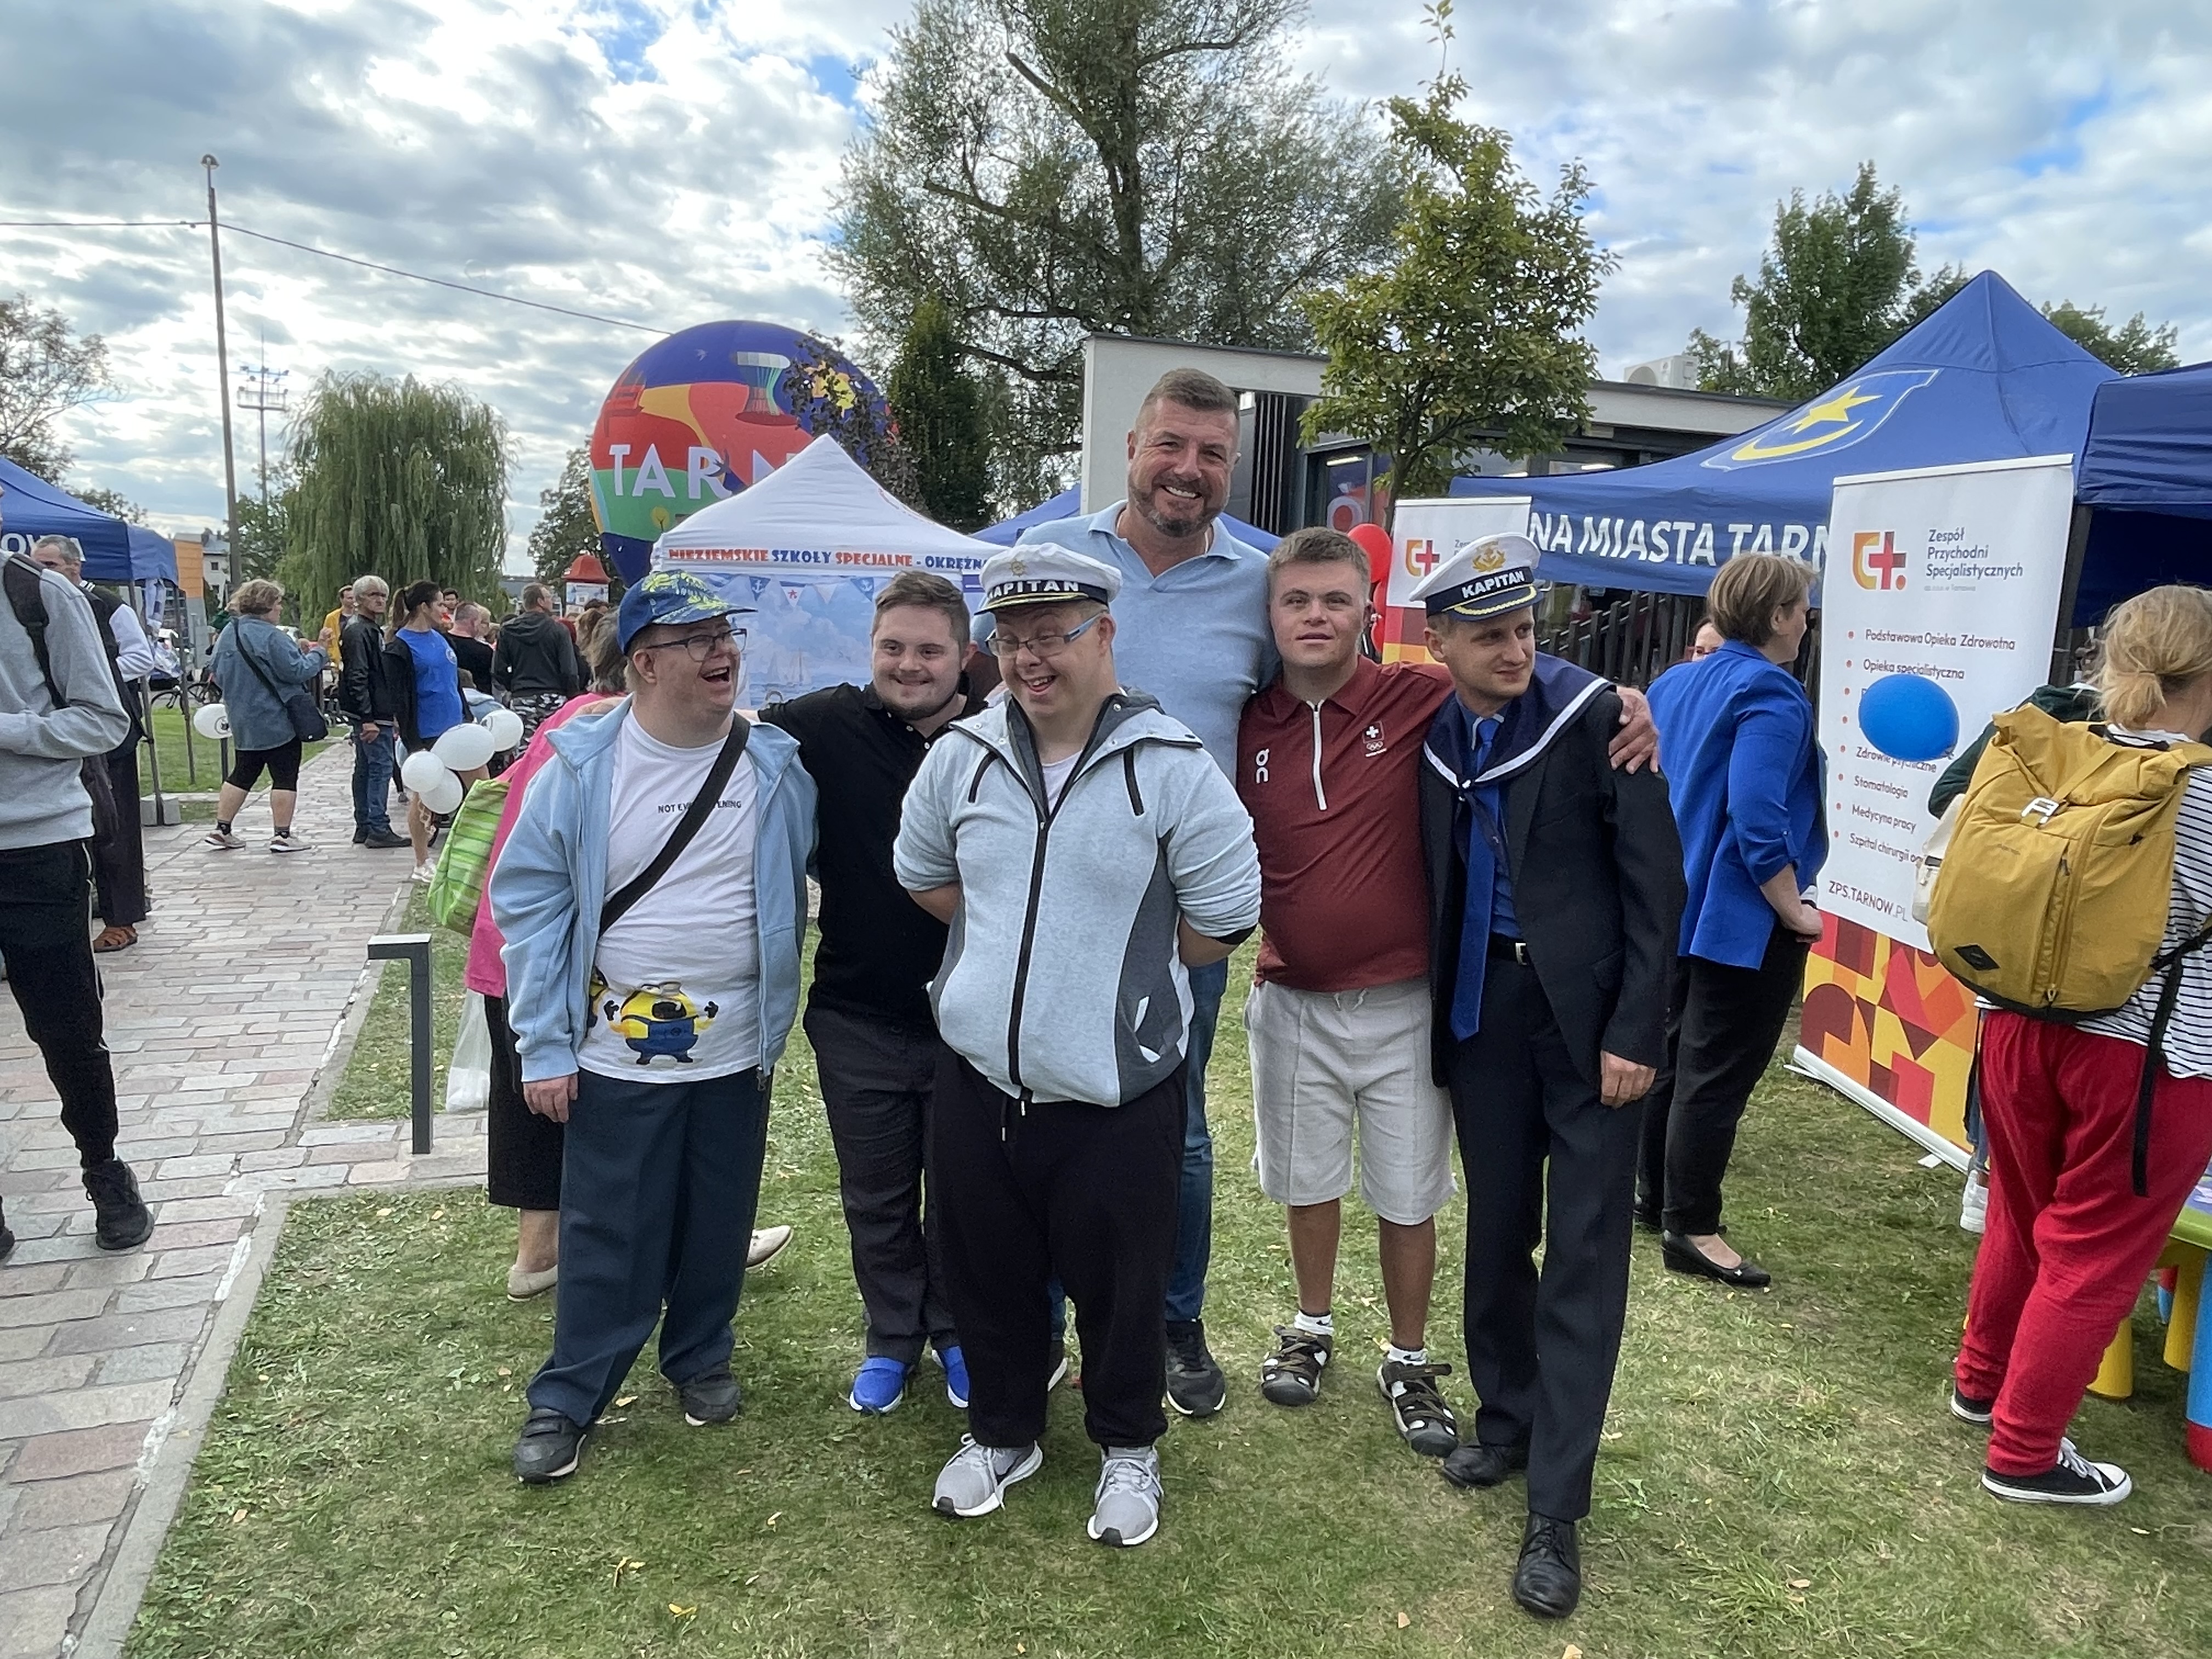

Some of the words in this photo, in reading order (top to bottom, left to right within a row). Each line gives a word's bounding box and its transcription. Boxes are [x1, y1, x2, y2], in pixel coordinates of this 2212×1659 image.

[1577, 516, 1716, 566] MIASTA
[1928, 527, 1965, 545] Zespół
[771, 550, 832, 563] SZKOŁY
[835, 552, 913, 567] SPECJALNE
[1927, 544, 1989, 562] Przychodni
[1926, 562, 2023, 580] Specjalistycznych
[1462, 571, 1525, 599] KAPITAN
[1865, 629, 1923, 644] Podstawowa
[1925, 632, 1956, 648] Opieka
[1960, 634, 2016, 650] Zdrowotna
[1863, 659, 1895, 673] Opieka
[1854, 775, 1909, 799] Stomatologia
[658, 804, 676, 813] NOT
[1852, 804, 1893, 825] Medycyna
[1893, 816, 1916, 834] pracy
[1849, 833, 1877, 850] Szpital
[1878, 841, 1910, 862] chirurgii
[1829, 880, 1908, 922] ZPS.TARNOW.PL
